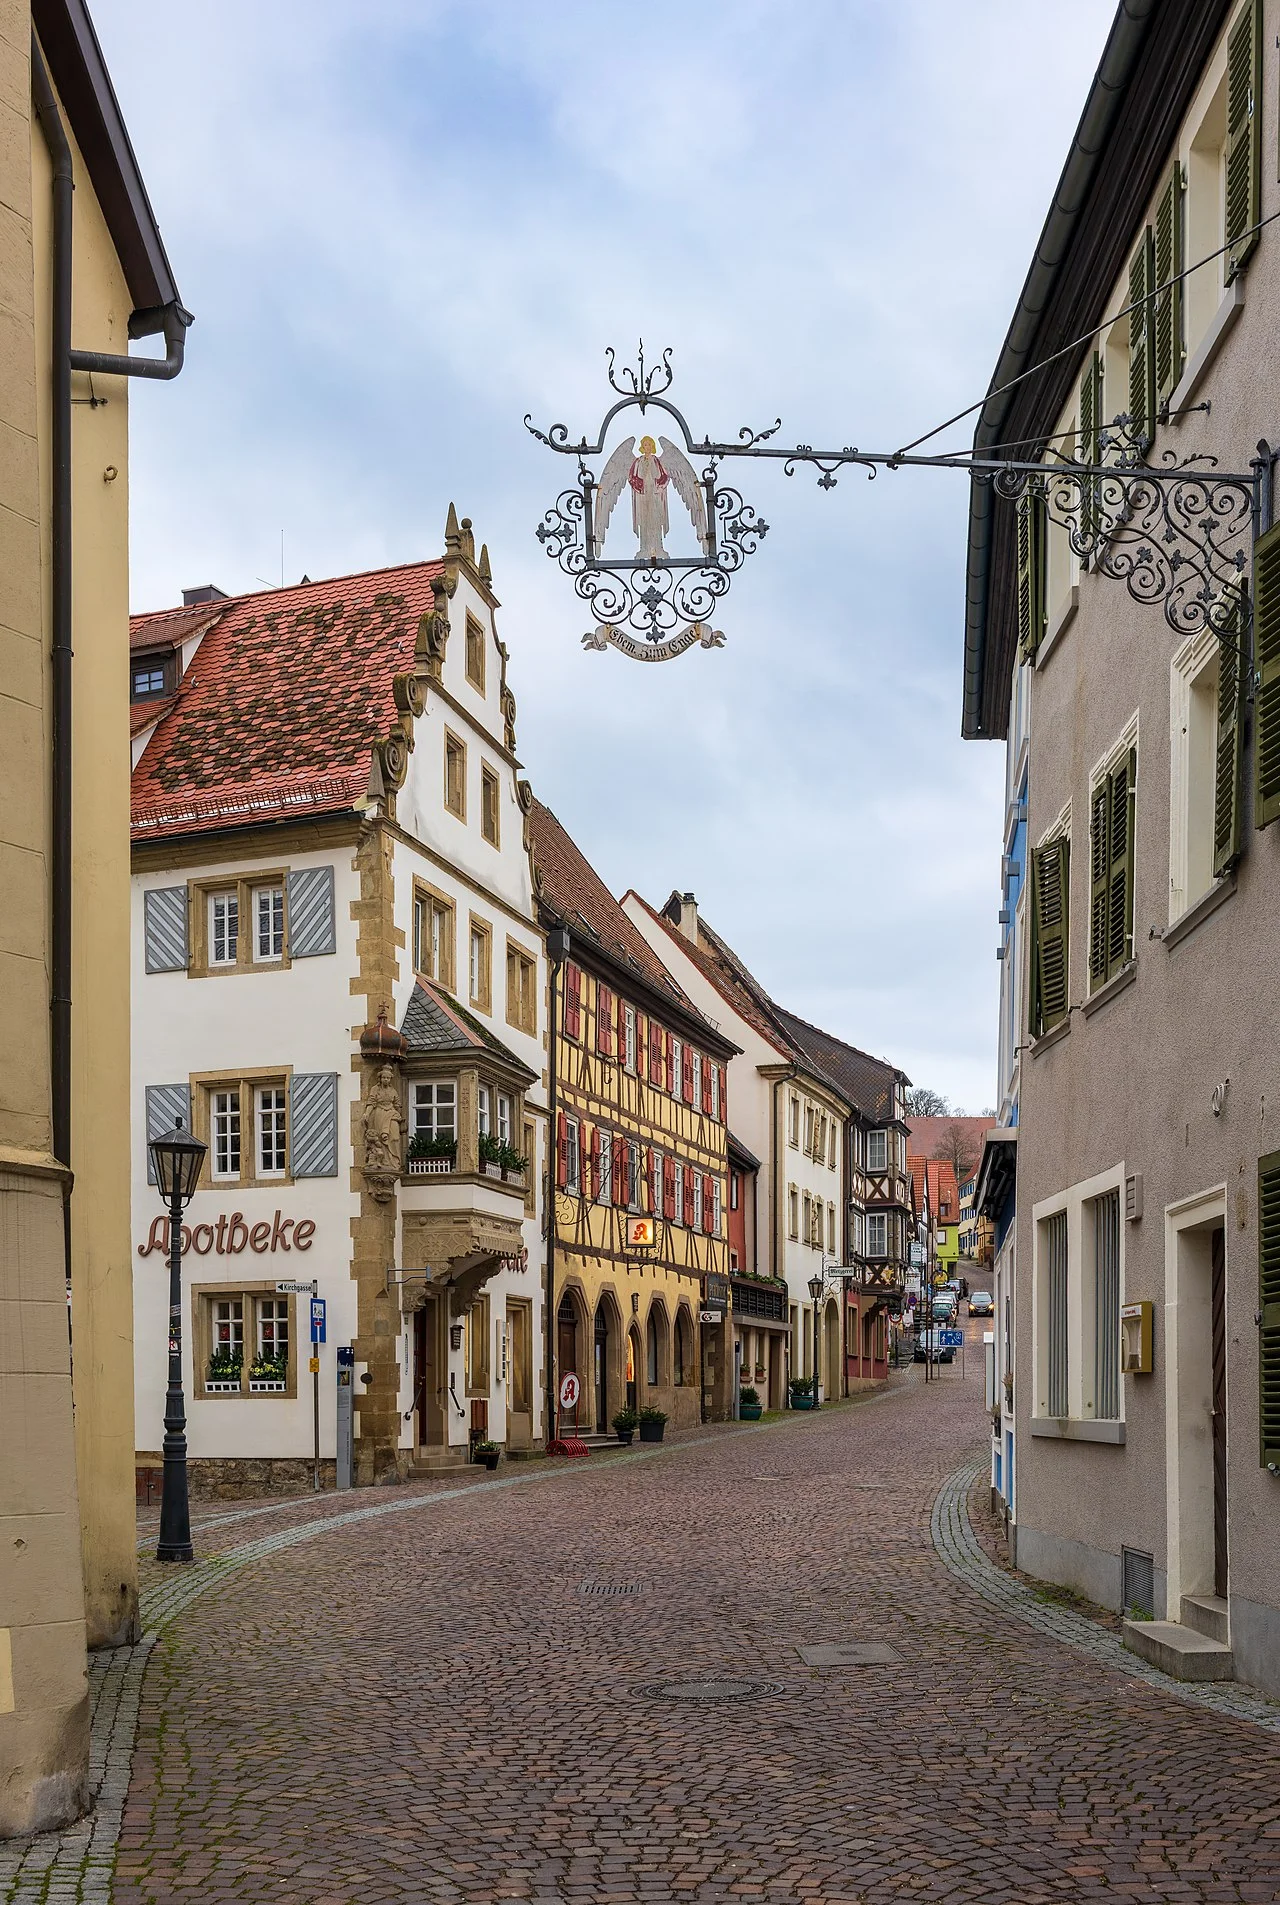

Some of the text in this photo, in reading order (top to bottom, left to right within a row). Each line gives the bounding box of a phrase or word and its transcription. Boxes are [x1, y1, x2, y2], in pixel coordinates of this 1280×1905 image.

[609, 627, 698, 659] Ehem. Zum Enge
[283, 1283, 312, 1293] Kirchgasse
